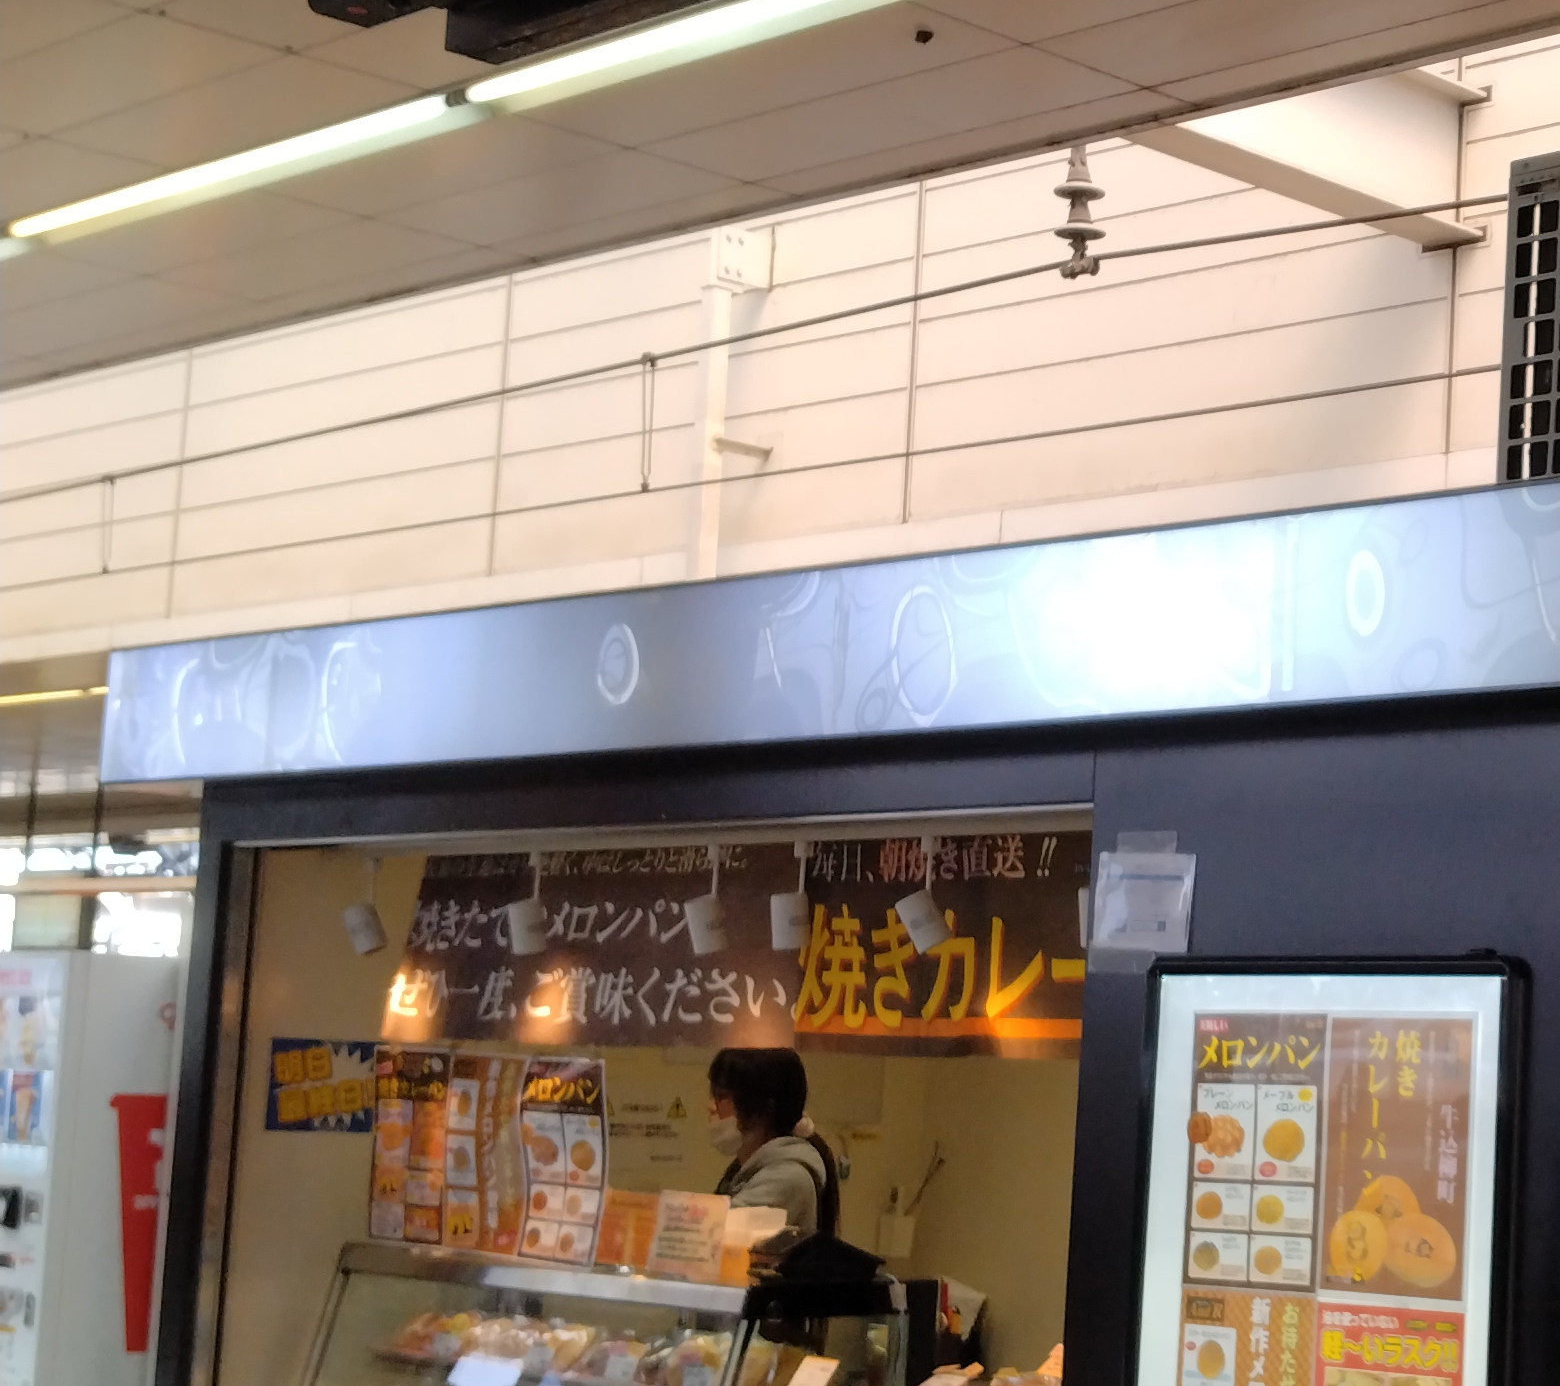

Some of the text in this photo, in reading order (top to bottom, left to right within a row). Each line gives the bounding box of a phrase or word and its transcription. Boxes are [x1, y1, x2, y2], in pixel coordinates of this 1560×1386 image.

[1197, 1035, 1321, 1070] メロンパン
